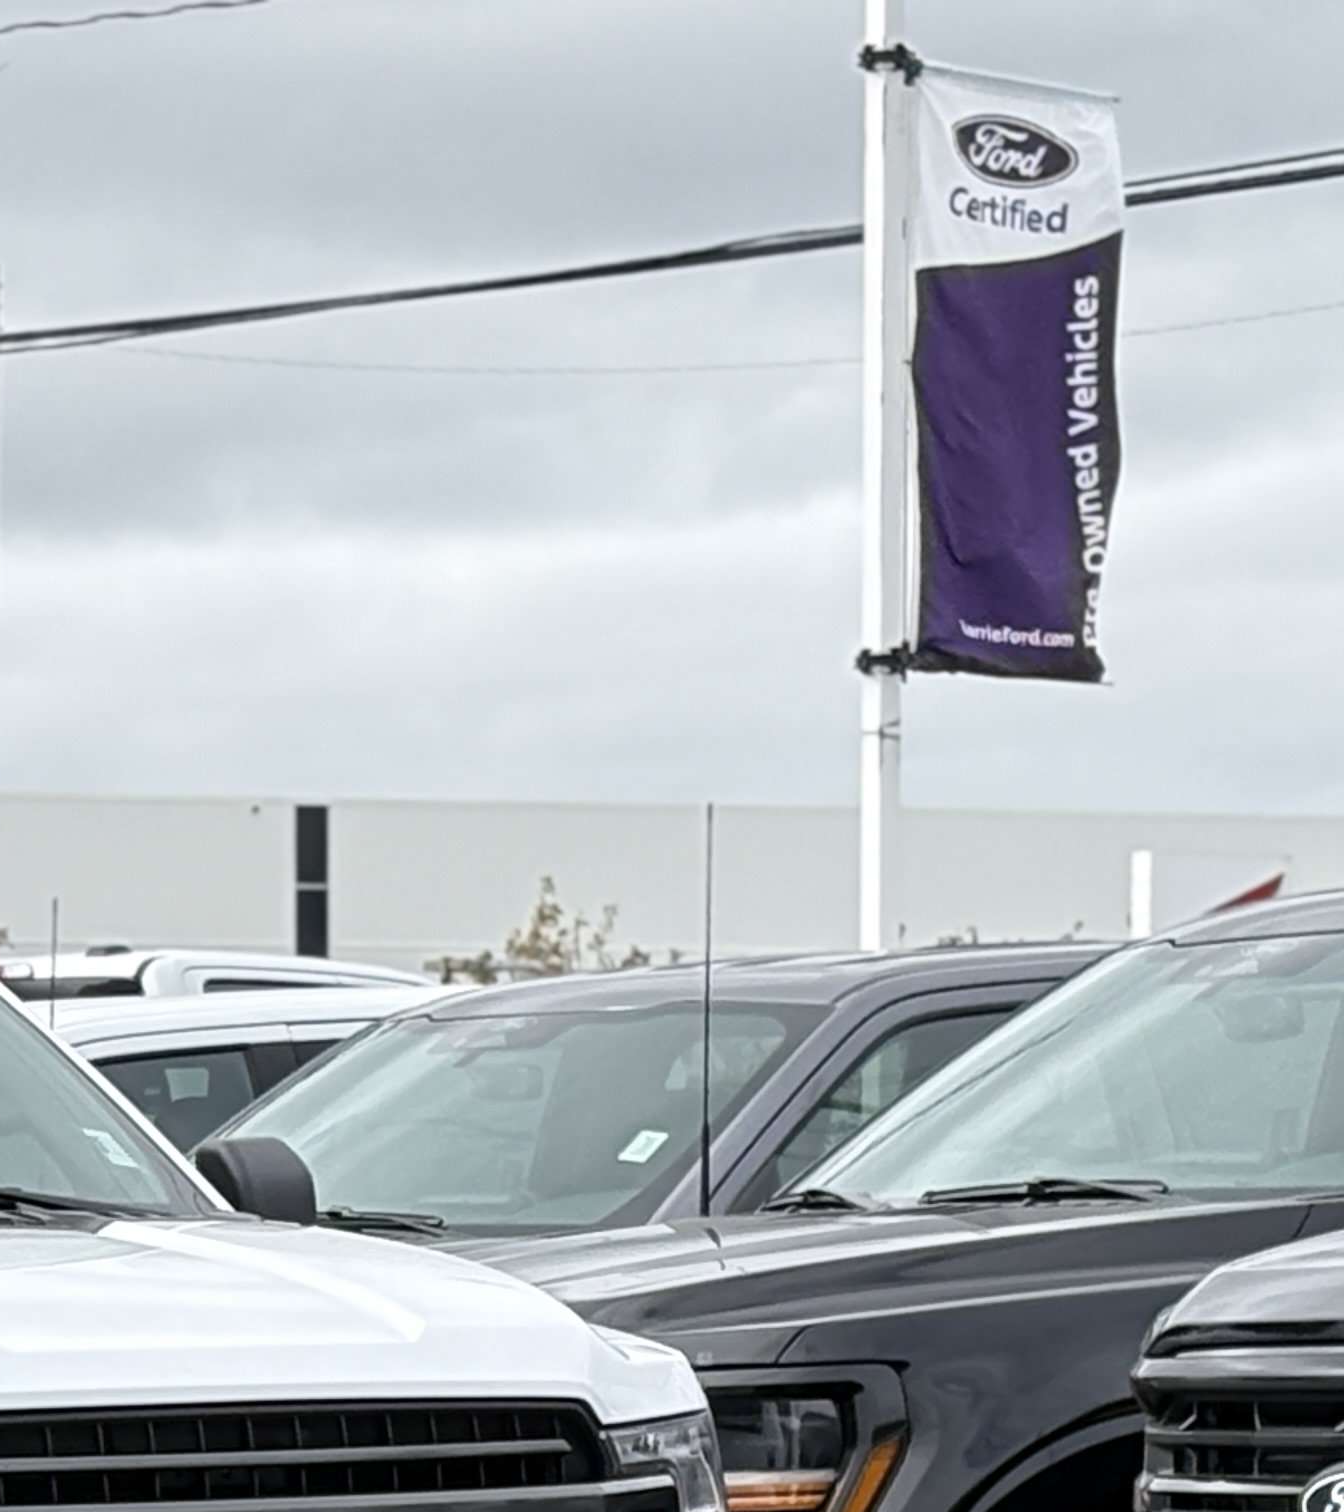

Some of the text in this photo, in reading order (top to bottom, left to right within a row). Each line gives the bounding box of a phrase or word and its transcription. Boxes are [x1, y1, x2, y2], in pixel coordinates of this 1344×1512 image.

[968, 123, 1049, 178] Ford
[949, 186, 1069, 233] Certified
[1066, 275, 1100, 436] Vehicles
